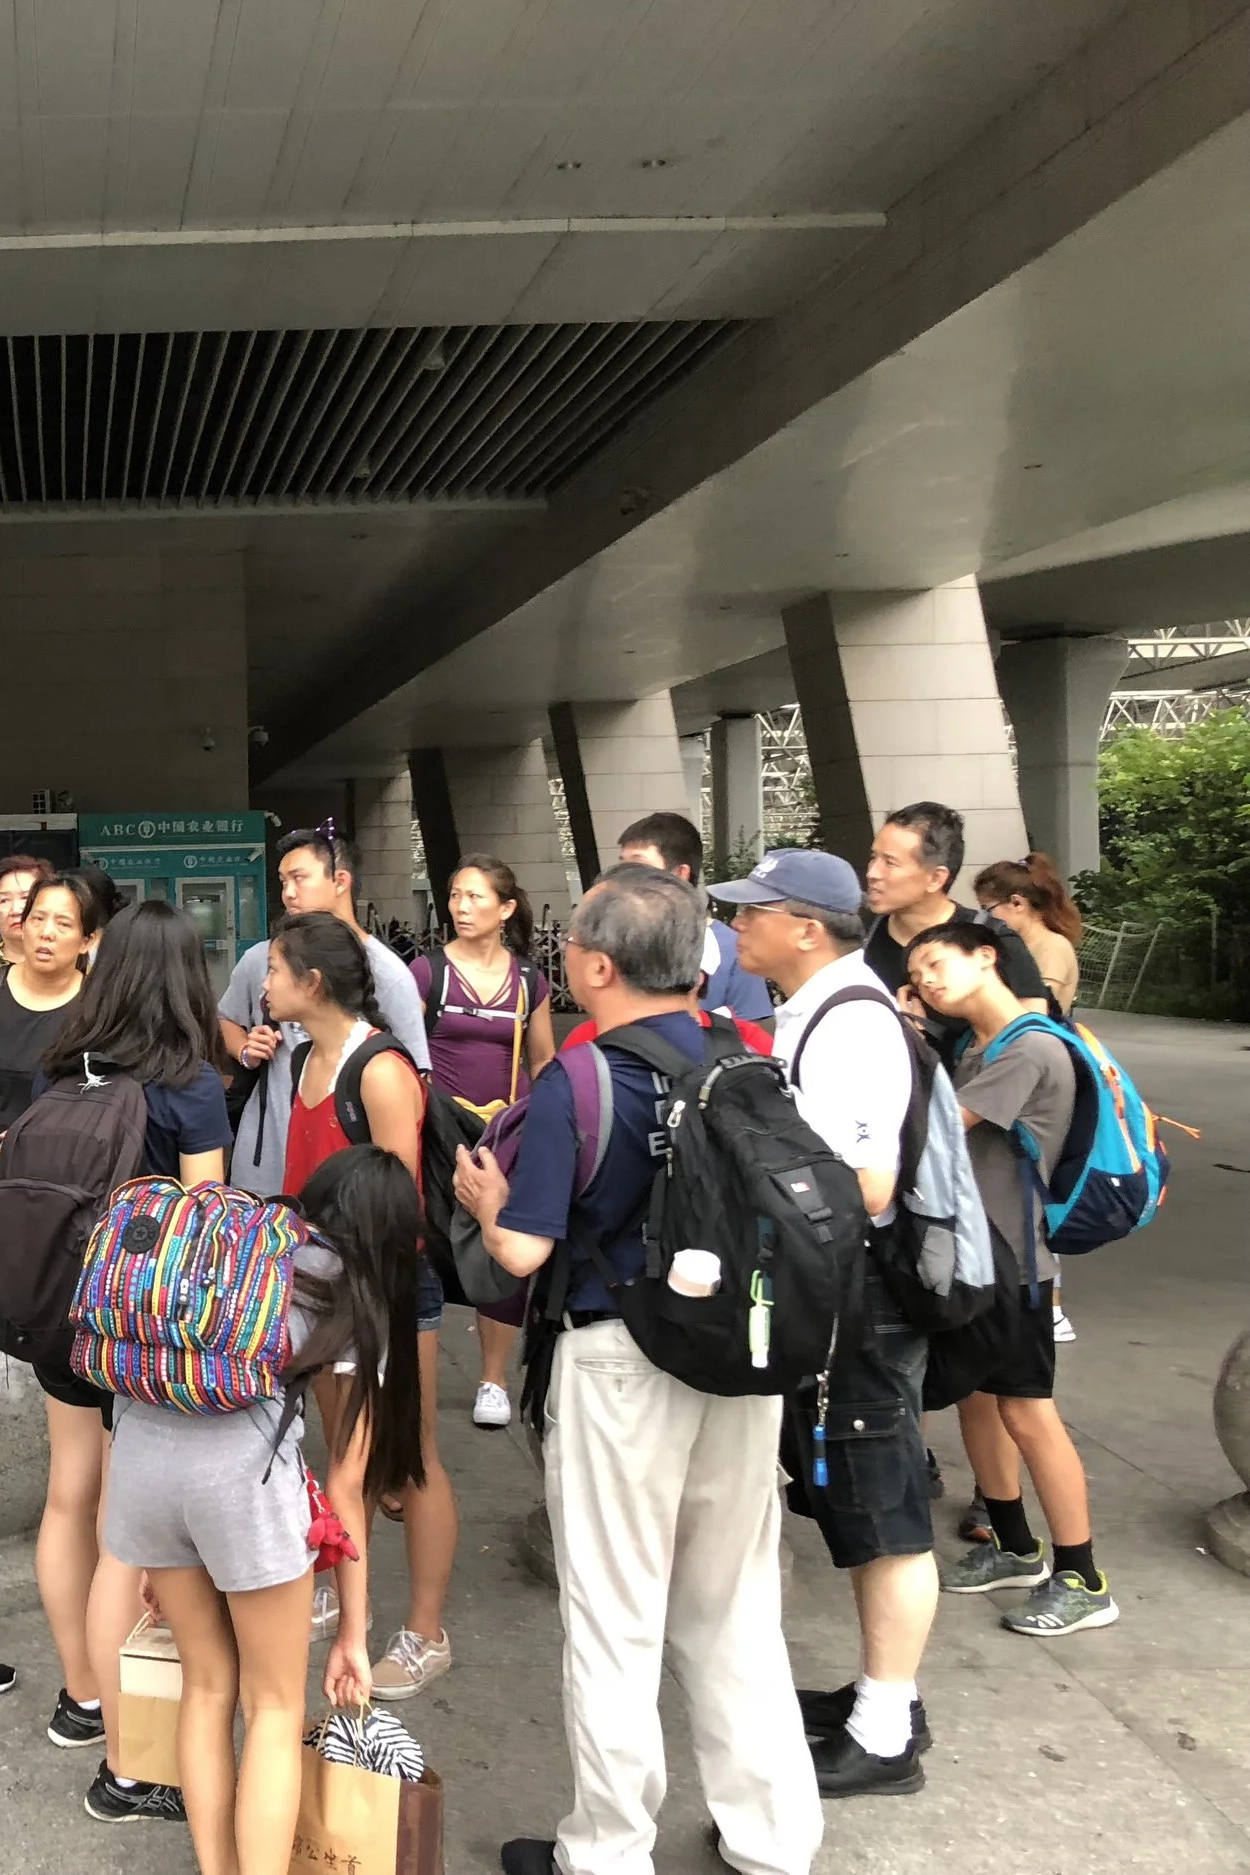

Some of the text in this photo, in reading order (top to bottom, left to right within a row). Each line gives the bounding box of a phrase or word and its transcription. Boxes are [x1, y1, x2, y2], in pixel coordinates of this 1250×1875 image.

[100, 819, 244, 837] ABC 中国农业银行
